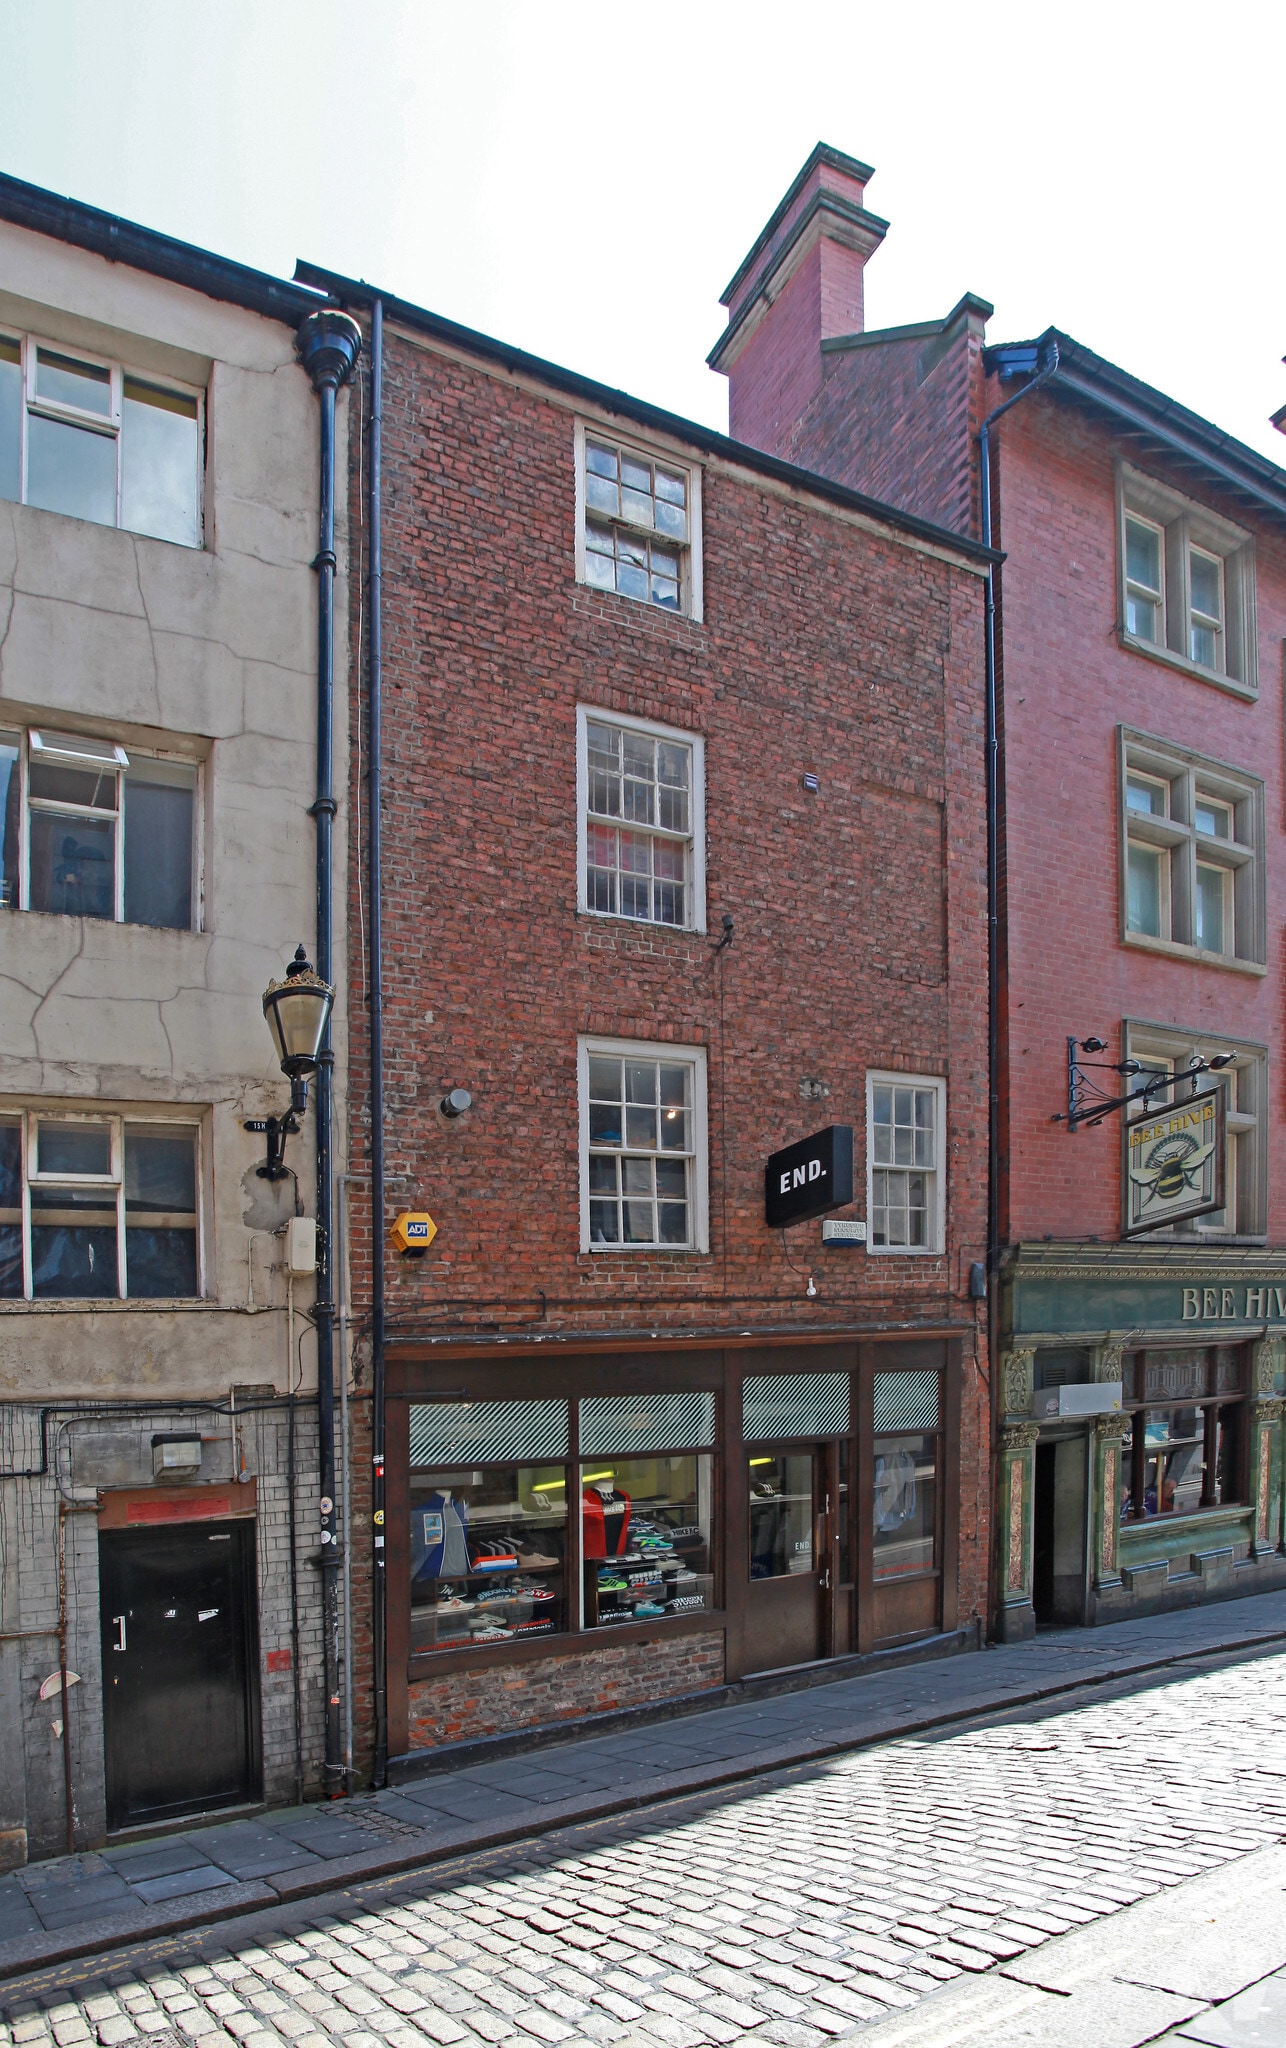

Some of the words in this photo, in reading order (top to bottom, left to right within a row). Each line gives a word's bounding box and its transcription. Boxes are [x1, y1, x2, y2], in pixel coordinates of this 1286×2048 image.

[1129, 1125, 1165, 1148] BEE
[1169, 1106, 1216, 1134] HIVE
[780, 1159, 827, 1194] END.
[408, 1224, 427, 1234] ADT
[1182, 1288, 1237, 1320] BEE
